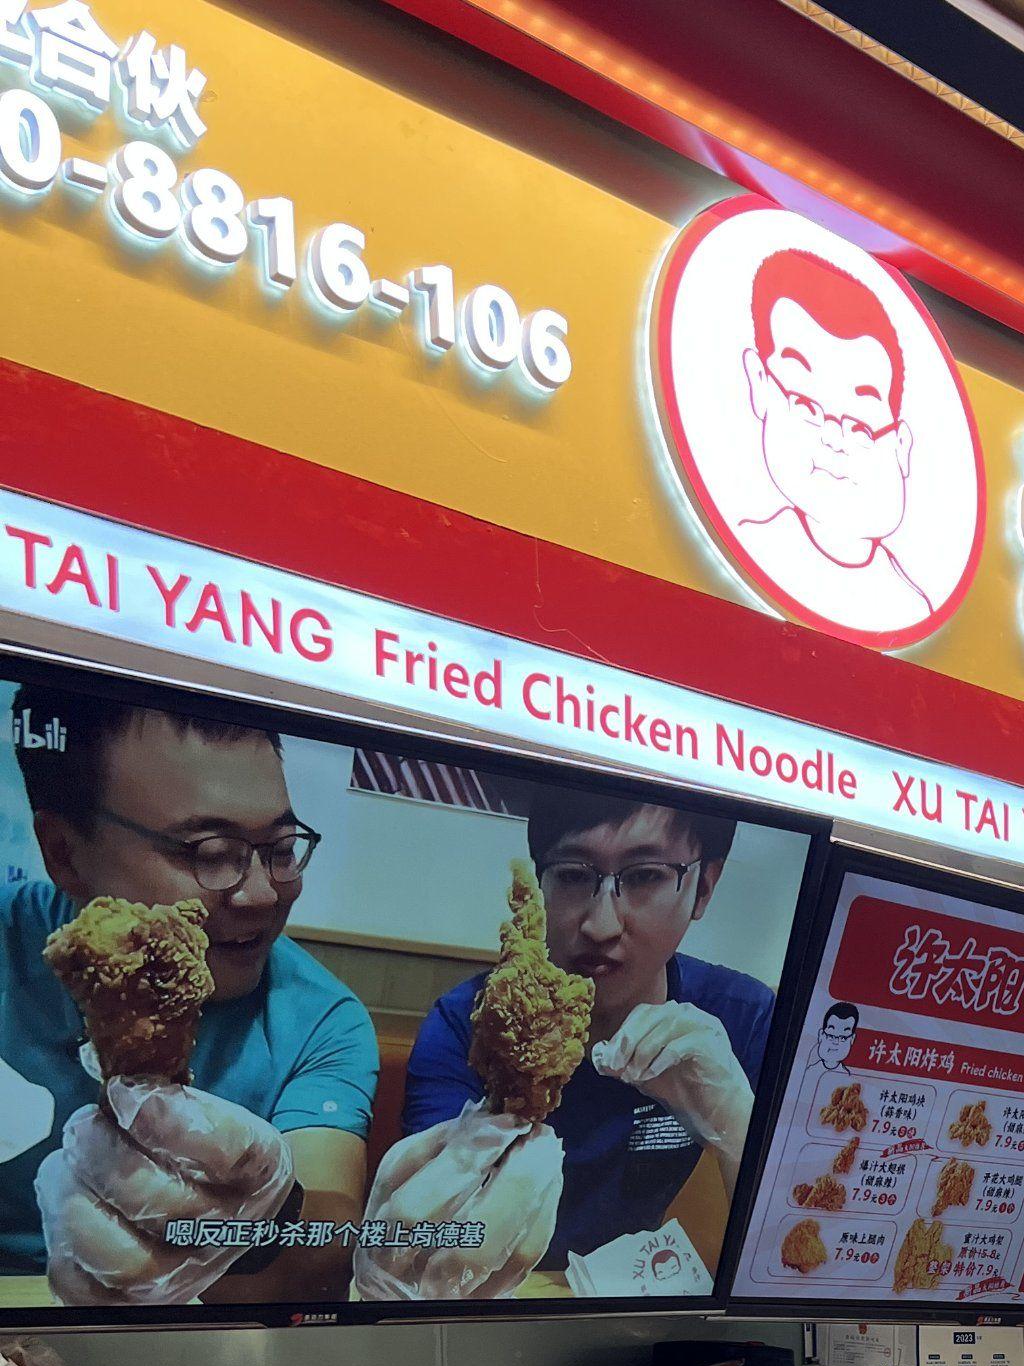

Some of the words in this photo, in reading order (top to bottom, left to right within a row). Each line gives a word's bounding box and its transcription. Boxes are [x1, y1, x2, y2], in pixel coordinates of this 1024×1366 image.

[4, 524, 118, 612] TAI
[146, 564, 334, 663] YANG
[374, 628, 503, 710] Fried
[522, 672, 699, 760] Chicken
[715, 722, 858, 800] Noodle
[892, 771, 943, 824] XU
[956, 789, 1009, 841] TAI
[868, 1039, 956, 1074] 许太阳炸鸡
[961, 1062, 987, 1078] Fried
[988, 1066, 1023, 1083] chicken
[165, 1220, 485, 1248] 嗯反正秒杀那个楼上肯德基
[955, 1333, 974, 1343] 2023
